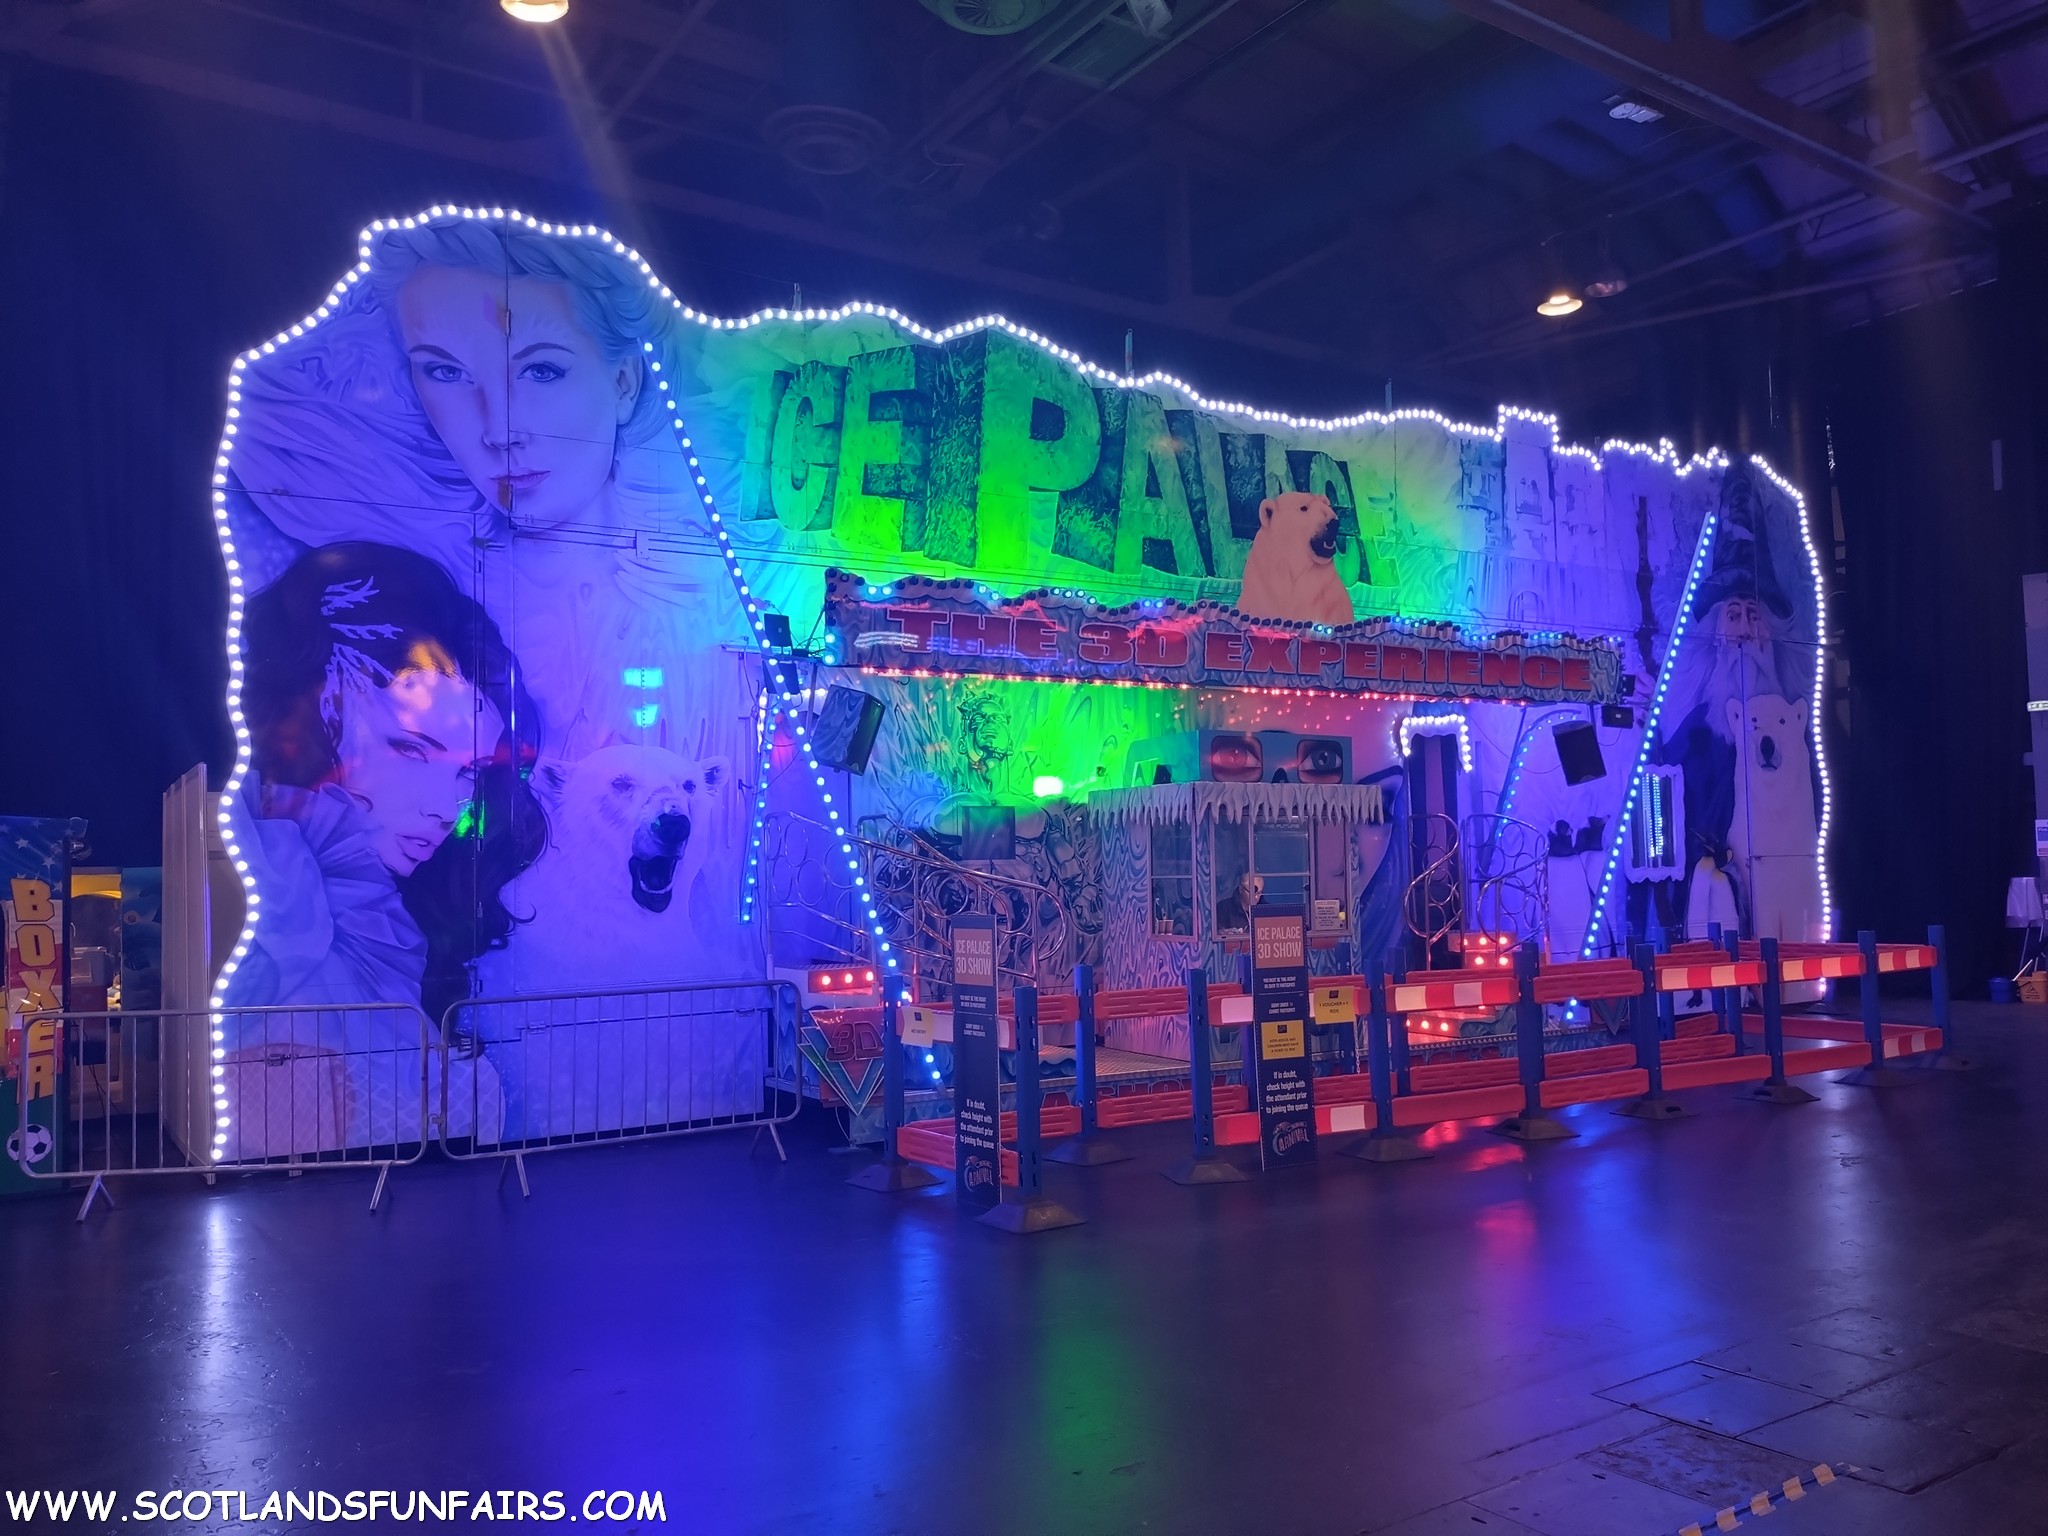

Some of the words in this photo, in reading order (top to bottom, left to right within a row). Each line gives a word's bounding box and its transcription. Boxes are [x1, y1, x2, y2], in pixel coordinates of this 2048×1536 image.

[739, 345, 925, 552] ICE
[887, 608, 1058, 660] THE
[1078, 623, 1189, 667] 3D
[1204, 631, 1591, 691] EXPERIENCE
[1257, 927, 1270, 940] ICE
[1271, 926, 1301, 940] PALACE
[956, 939, 966, 954] ICE
[966, 940, 991, 955] PALACE
[1257, 943, 1271, 959] 3D
[1273, 941, 1302, 959] SHOW
[956, 956, 967, 974] 3D
[968, 957, 991, 976] SHOW
[10, 878, 64, 1104] BOXER
[825, 1021, 884, 1062] 3D
[1283, 1070, 1297, 1079] doubt,
[1266, 1083, 1280, 1091] check
[1281, 1082, 1295, 1091] height
[1295, 1080, 1306, 1088] with
[1274, 1093, 1296, 1101] attendant
[1296, 1091, 1307, 1100] prior
[1272, 1105, 1287, 1114] joining
[1295, 1103, 1309, 1111] queue
[960, 1110, 971, 1119] check
[971, 1112, 983, 1122] height
[984, 1114, 993, 1123] with
[967, 1124, 984, 1135] attendant
[984, 1128, 993, 1136] prior
[964, 1135, 976, 1147] joining
[983, 1141, 994, 1149] queue
[1272, 1127, 1310, 1156] CARNIVAL
